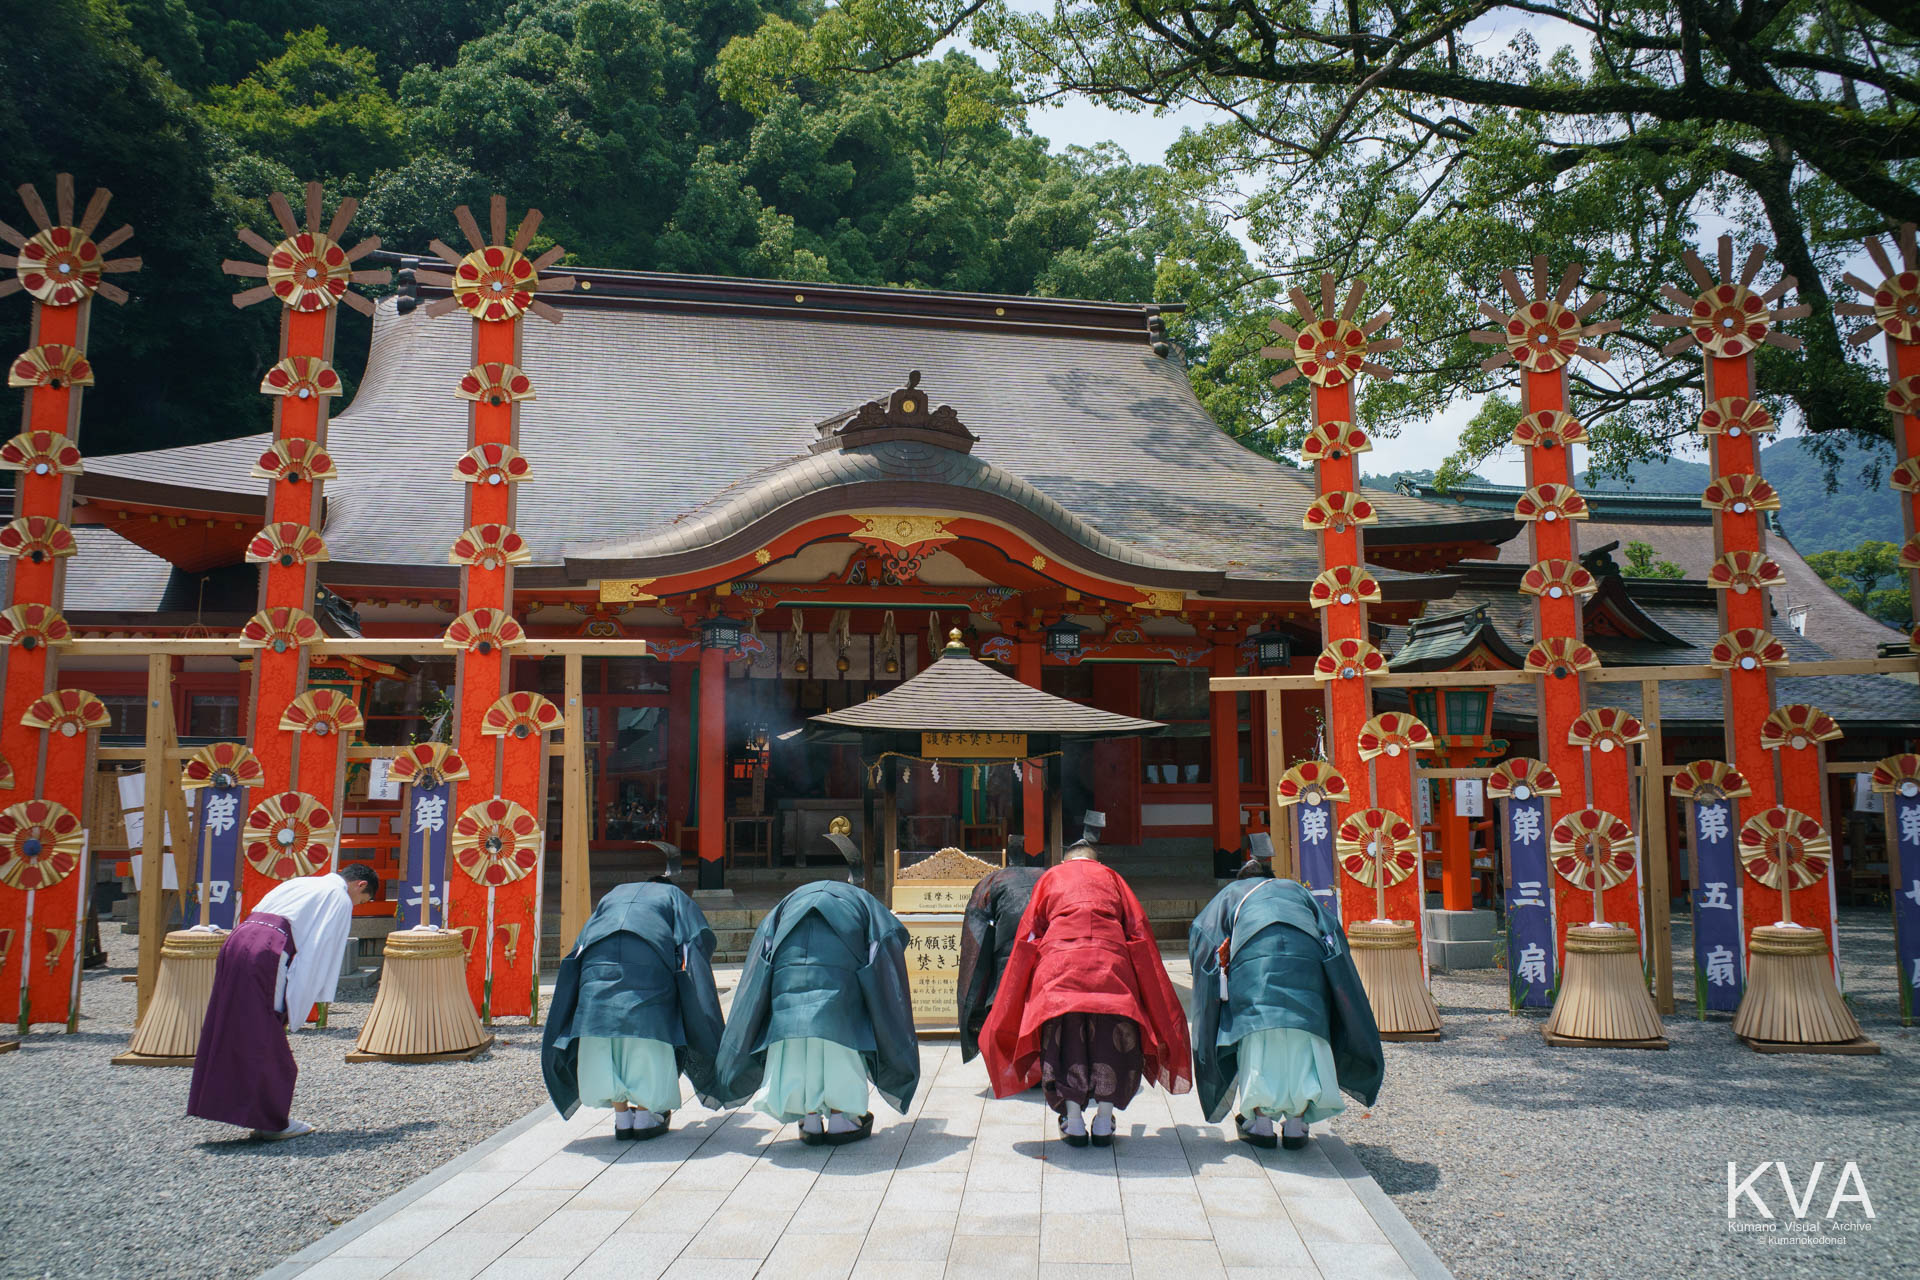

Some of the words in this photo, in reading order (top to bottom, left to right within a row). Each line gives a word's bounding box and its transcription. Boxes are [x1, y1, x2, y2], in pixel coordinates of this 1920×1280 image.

[908, 934, 962, 952] 祈願護
[1512, 807, 1546, 984] 第三扇
[1698, 803, 1737, 987] 第五扇
